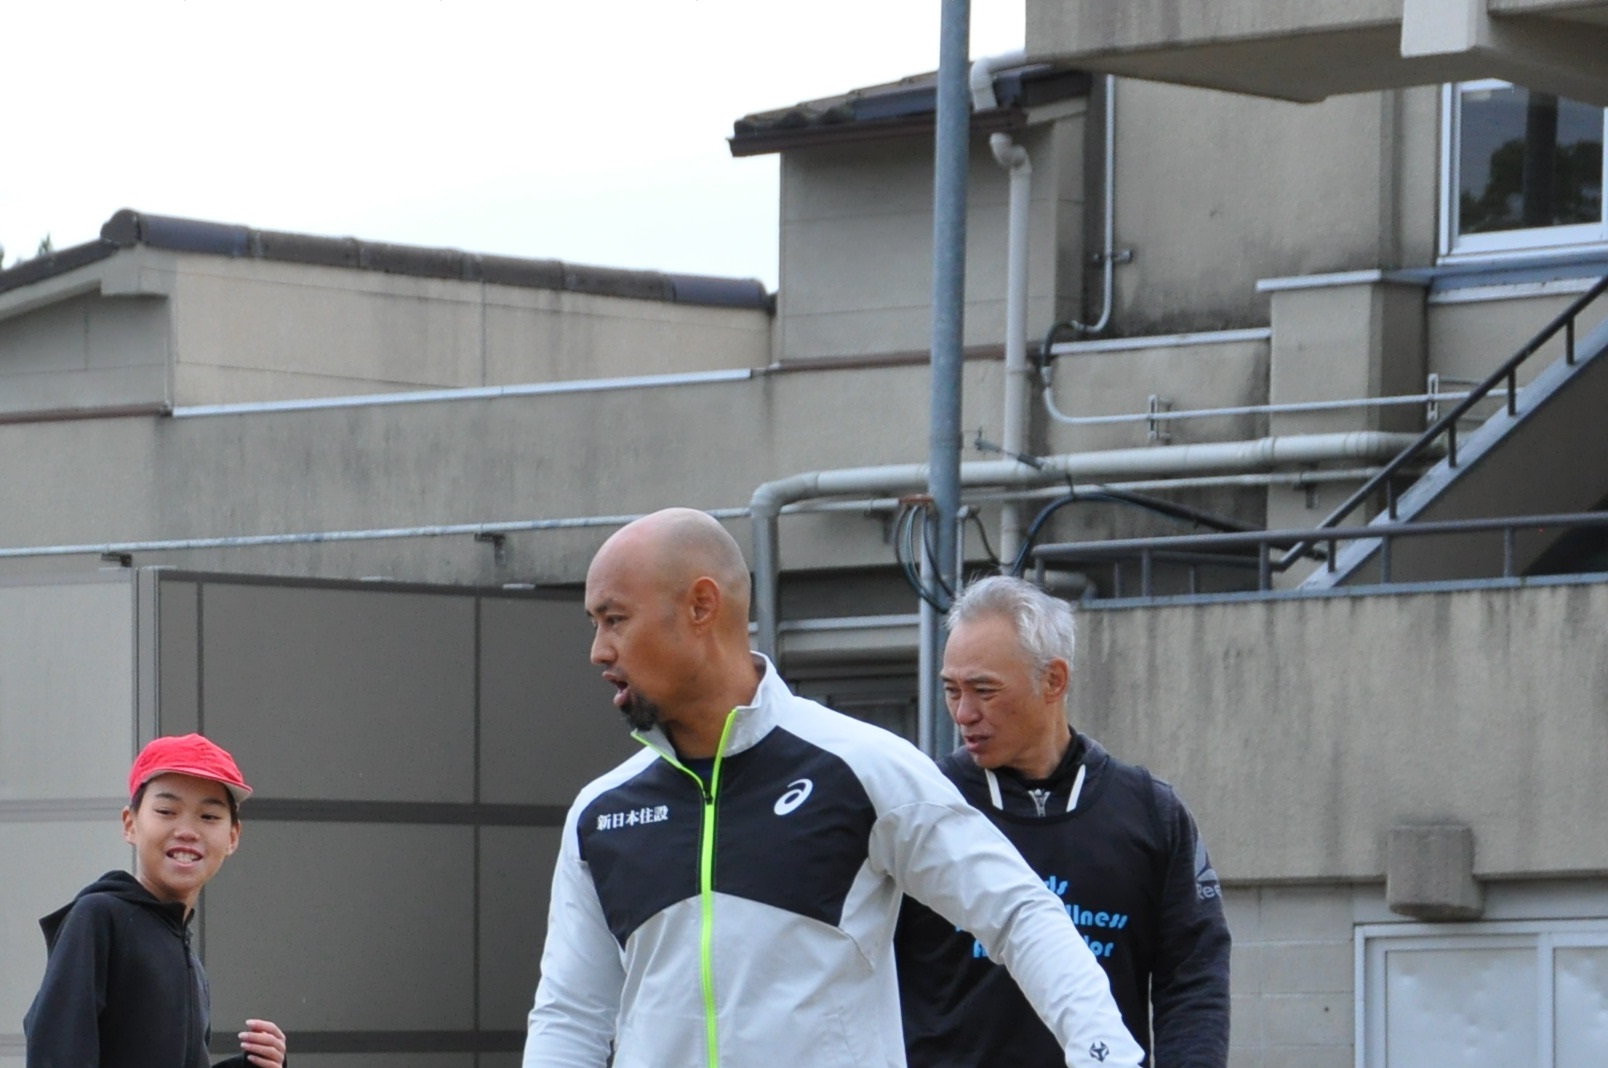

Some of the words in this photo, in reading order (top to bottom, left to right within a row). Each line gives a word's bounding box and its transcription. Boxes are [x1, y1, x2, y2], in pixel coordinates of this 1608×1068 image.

[596, 805, 669, 831] 新日本住設
